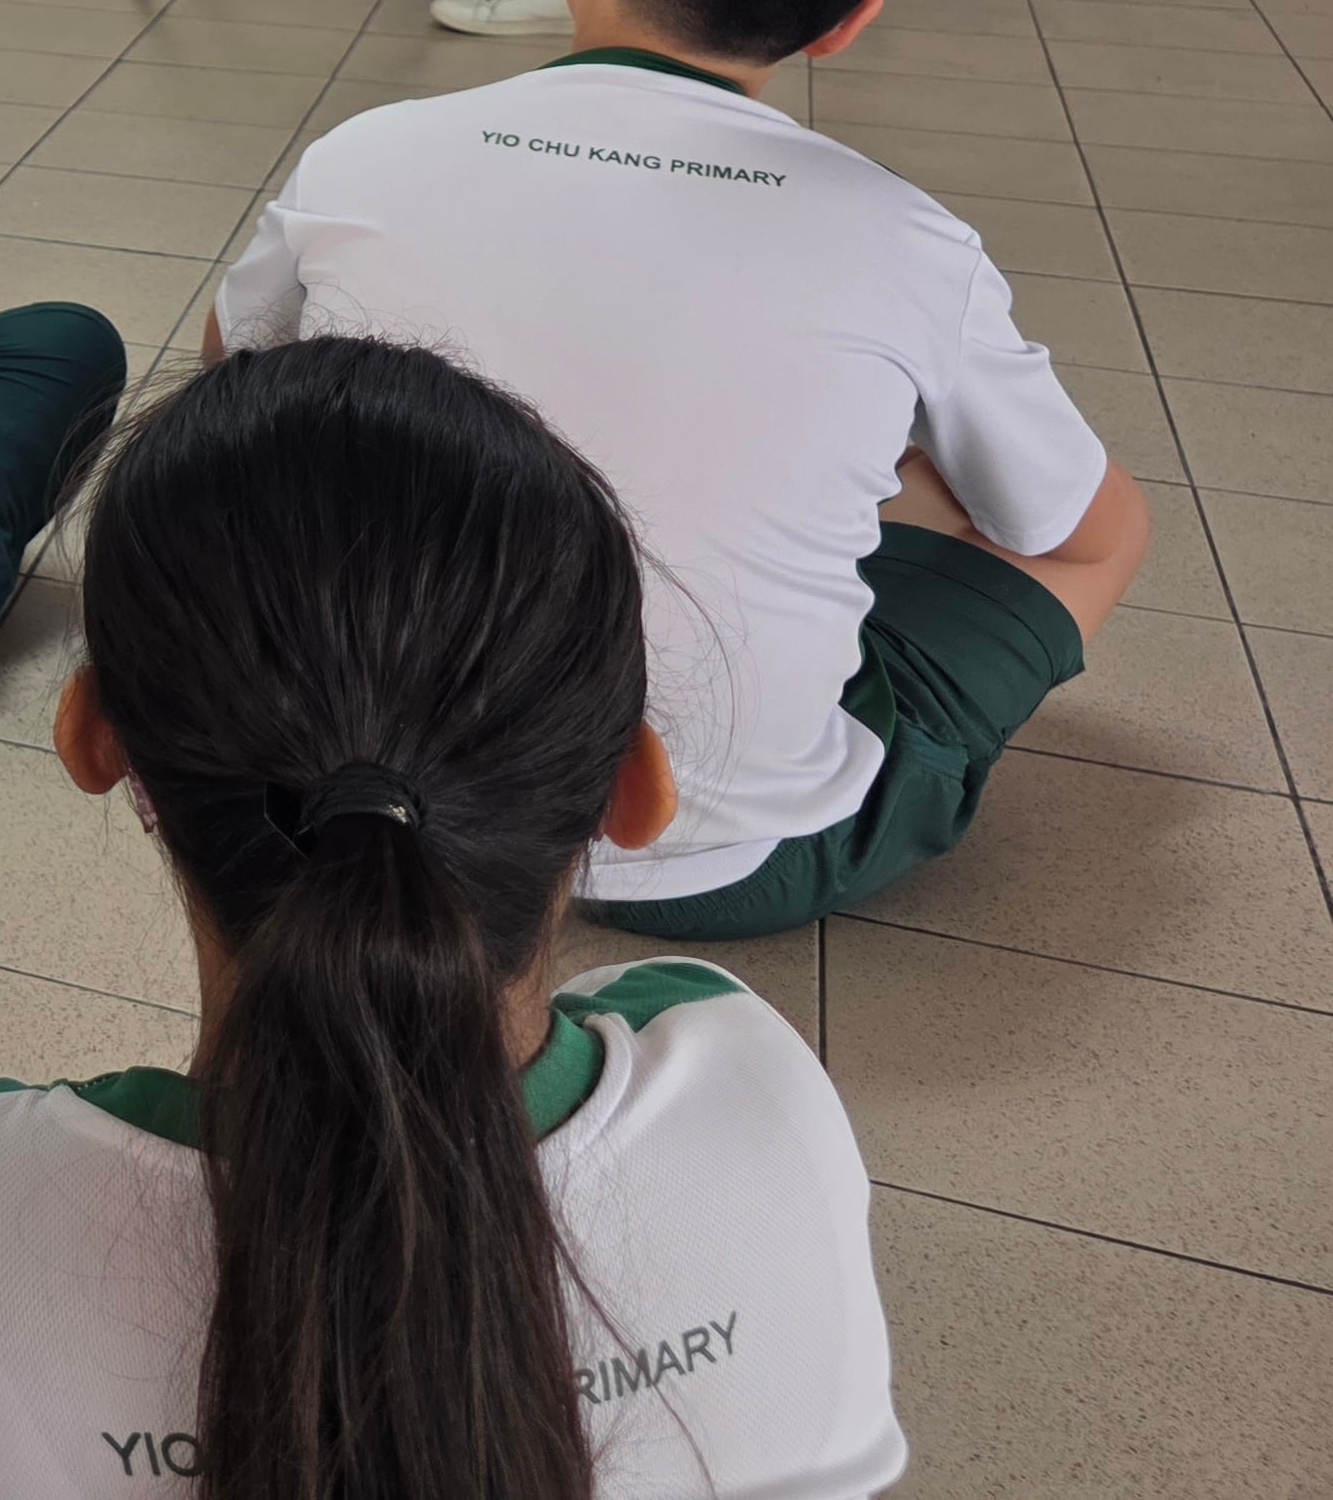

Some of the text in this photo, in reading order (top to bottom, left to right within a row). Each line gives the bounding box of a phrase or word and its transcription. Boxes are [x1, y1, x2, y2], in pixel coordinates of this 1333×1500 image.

[481, 130, 787, 187] YIO CHU KANG PRIMARY
[572, 1311, 737, 1405] RIMARY
[101, 1431, 208, 1478] YIO
